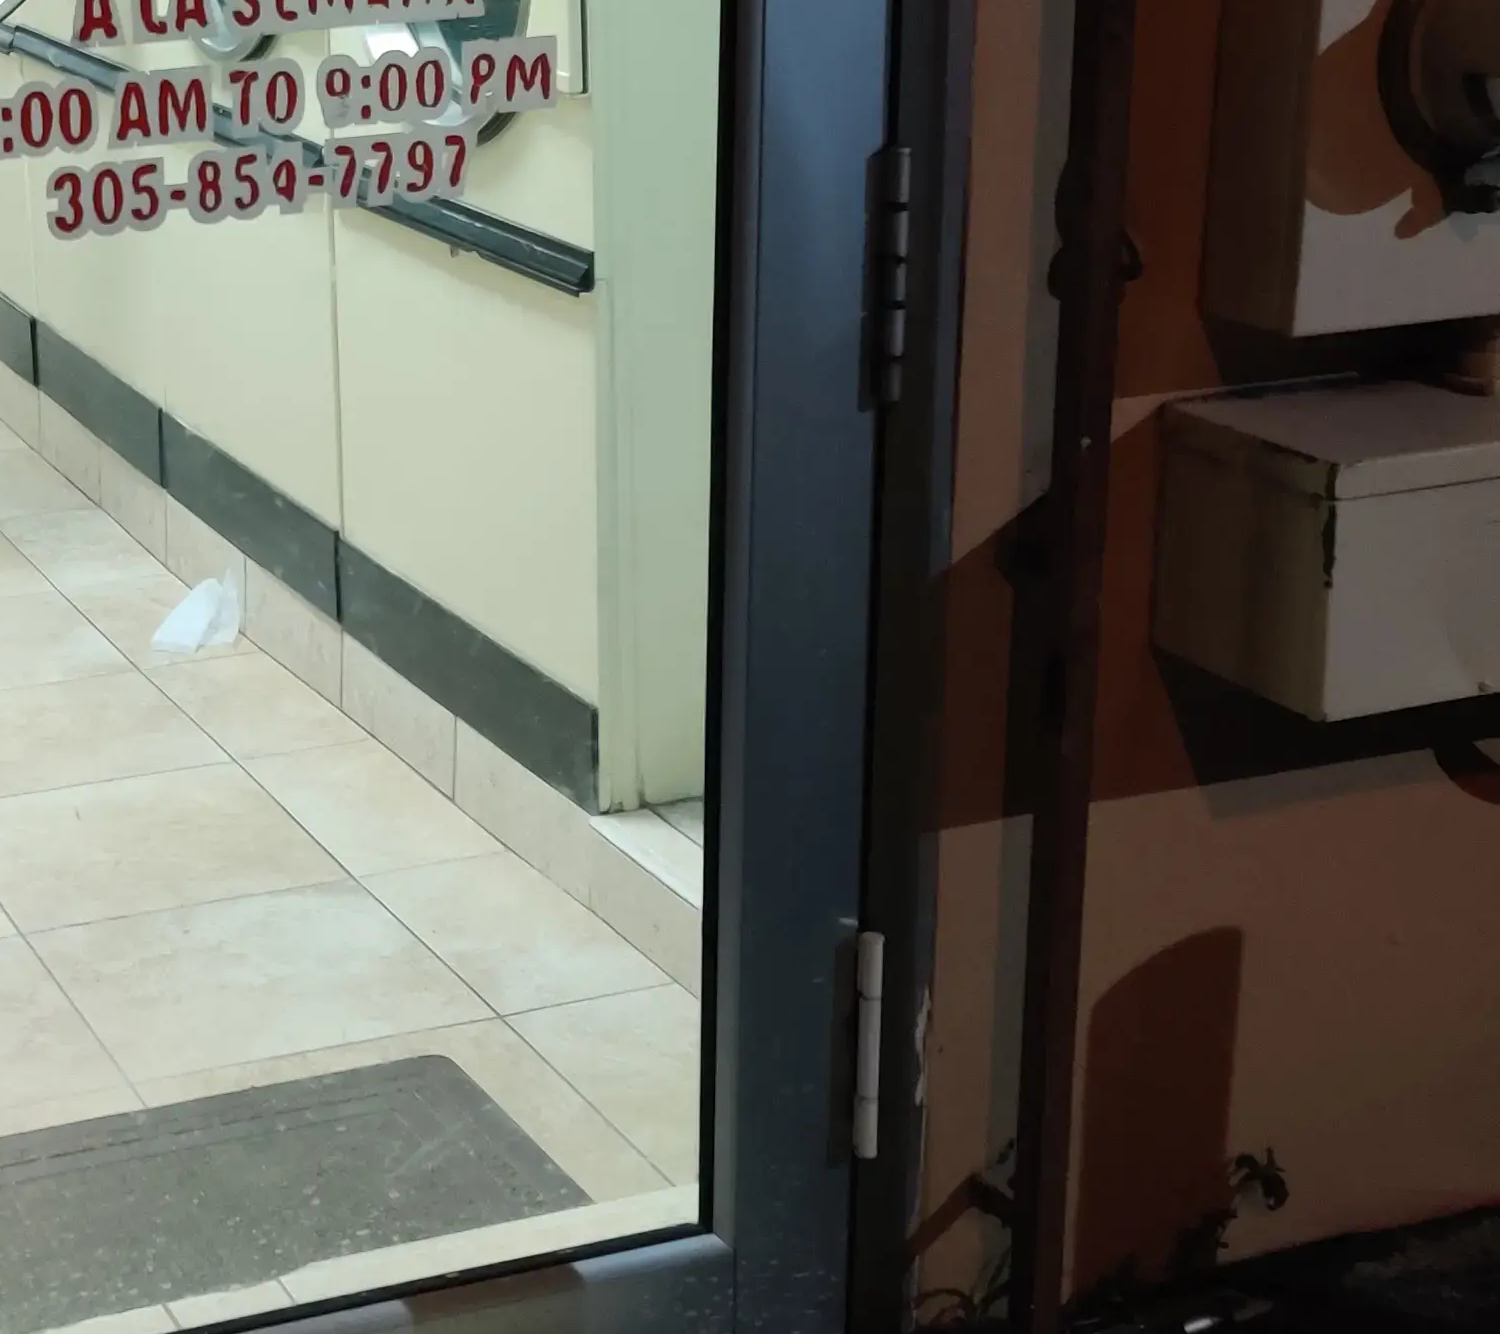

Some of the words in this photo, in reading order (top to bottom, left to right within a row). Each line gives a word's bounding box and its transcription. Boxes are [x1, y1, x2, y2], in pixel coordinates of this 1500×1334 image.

[115, 76, 208, 142] AM
[228, 68, 300, 126] TO
[469, 52, 552, 105] PM
[52, 134, 467, 235] 305-854-7797
